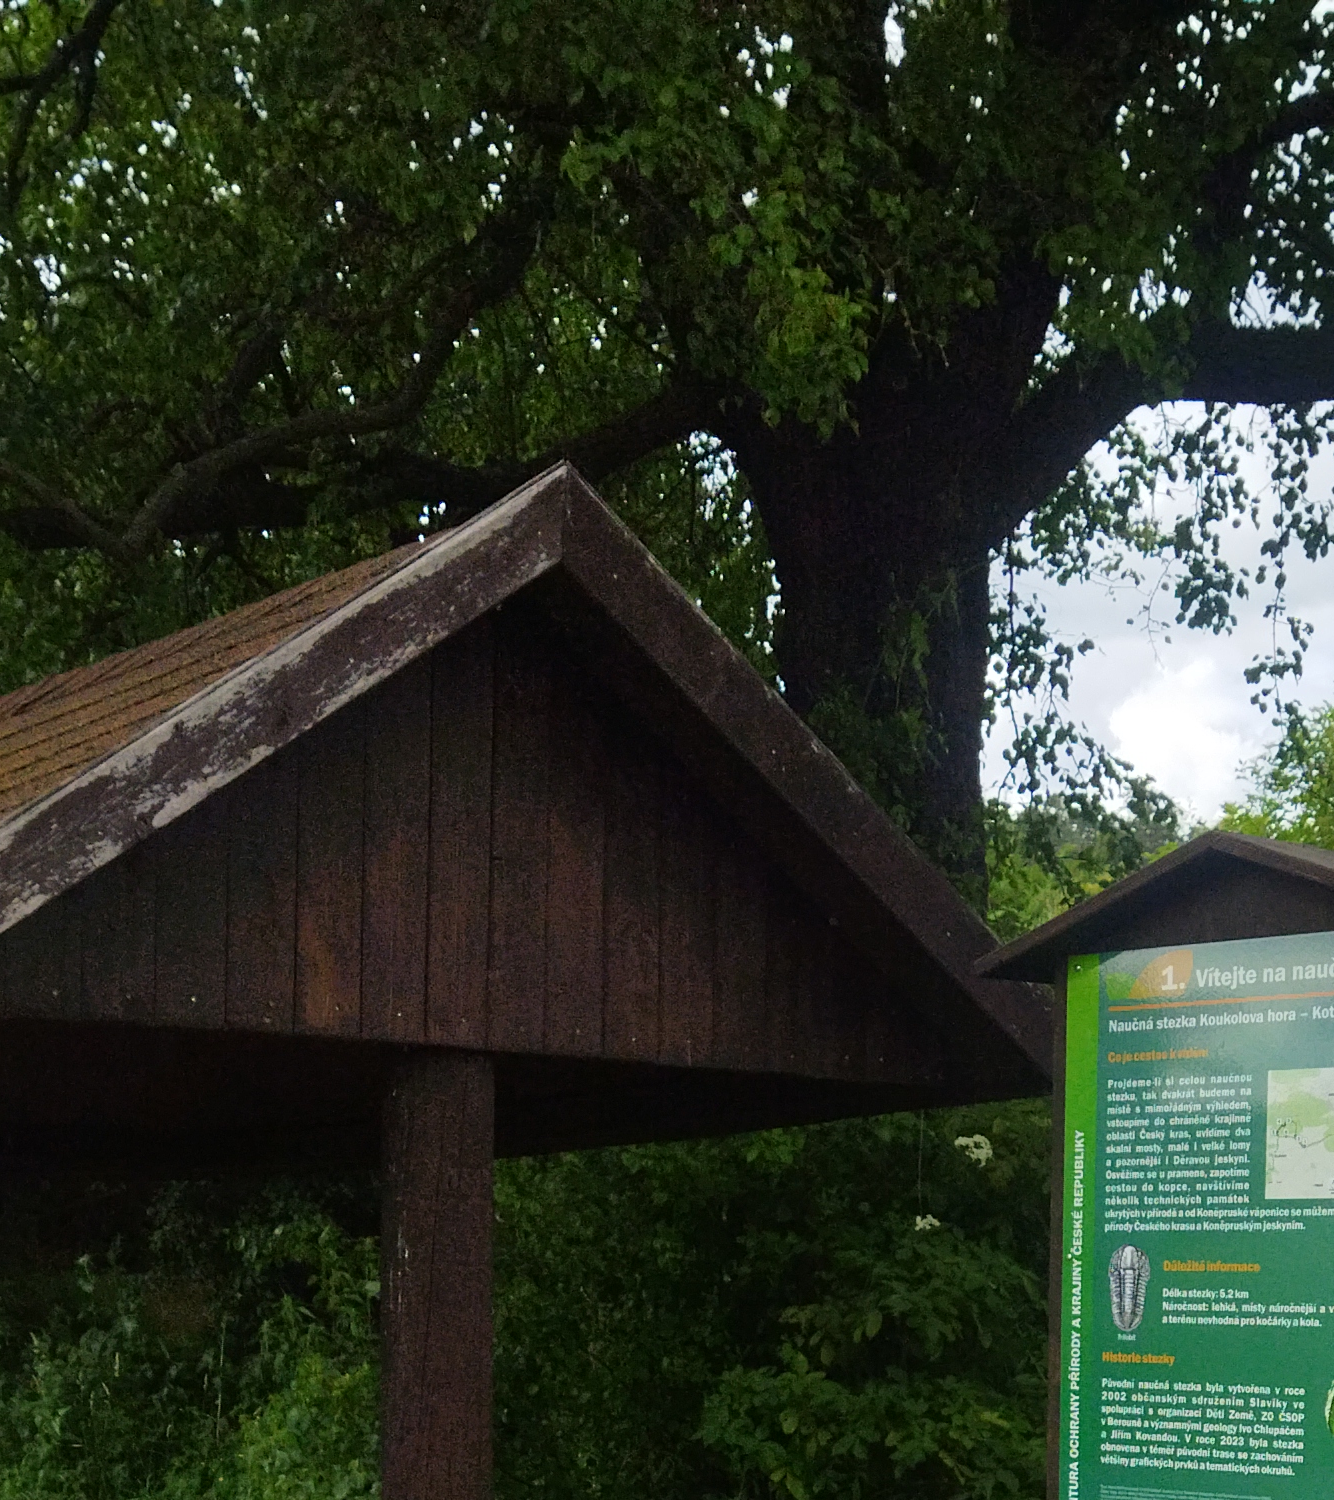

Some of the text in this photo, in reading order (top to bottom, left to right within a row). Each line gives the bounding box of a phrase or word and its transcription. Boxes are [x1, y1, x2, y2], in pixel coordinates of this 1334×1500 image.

[1161, 964, 1186, 990] 1.
[1195, 964, 1257, 991] Vítejte
[1263, 966, 1286, 982] na
[1109, 1017, 1154, 1032] Naučná
[1157, 1015, 1196, 1029] stezka
[1200, 1010, 1264, 1026] Koukolova
[1267, 1008, 1296, 1021] hora
[1107, 1077, 1162, 1089] Projdeme-li
[1179, 1075, 1206, 1085] celou
[1210, 1074, 1252, 1083] naučnou
[1107, 1091, 1138, 1101] stezku,
[1142, 1091, 1157, 1099] tak
[1161, 1089, 1195, 1099] dvakrát
[1199, 1087, 1236, 1097] budeme
[1154, 1116, 1166, 1125] do
[1106, 1127, 1136, 1140] oblasti
[1169, 1129, 1192, 1139] kras,
[1196, 1127, 1231, 1137] uvidíme
[1235, 1126, 1251, 1136] dva
[1105, 1144, 1132, 1153] skalní
[1135, 1143, 1164, 1154] mosty,
[1168, 1142, 1190, 1151] malé
[1201, 1141, 1225, 1150] velké
[1229, 1140, 1251, 1151] lomy
[1173, 1154, 1210, 1164] Děravou
[1075, 1130, 1086, 1206] REPUBLIKY
[1105, 1183, 1137, 1192] cestou
[1142, 1182, 1154, 1191] do
[1158, 1182, 1191, 1192] kopce,
[1105, 1195, 1140, 1205] několik
[1207, 1194, 1250, 1204] památek
[1185, 1208, 1196, 1216] od
[1291, 1208, 1302, 1216] se
[1071, 1210, 1084, 1254] ČESKÉ
[1171, 1222, 1195, 1230] krasu
[1073, 1258, 1083, 1314] KRAJINY
[1162, 1288, 1188, 1297] Délka
[1188, 1288, 1219, 1298] stezky:
[1234, 1289, 1249, 1298] km
[1242, 1302, 1266, 1313] místy
[1169, 1314, 1197, 1323] terénu
[1240, 1317, 1256, 1327] pro
[1299, 1317, 1323, 1326] kola.
[1070, 1331, 1082, 1389] PŘÍRODY
[1173, 1381, 1201, 1391] stezka
[1206, 1382, 1224, 1393] byla
[1284, 1387, 1306, 1395] roce
[1101, 1391, 1127, 1401] 2002
[1249, 1397, 1288, 1412] Slavíky
[1293, 1401, 1305, 1409] ve
[1206, 1408, 1225, 1418] Děti
[1261, 1411, 1274, 1421] ZO
[1278, 1410, 1305, 1422] ČSOP
[1071, 1393, 1081, 1458] OCHRANY
[1107, 1416, 1142, 1427] Berouně
[1203, 1422, 1237, 1434] geology
[1239, 1424, 1252, 1433] Ivo
[1195, 1436, 1215, 1444] roce
[1220, 1435, 1244, 1446] 2023
[1249, 1437, 1268, 1449] byla
[1272, 1439, 1304, 1449] stezka
[1100, 1441, 1140, 1452] obnovena
[1212, 1448, 1235, 1458] trase
[1237, 1451, 1248, 1459] se
[1175, 1459, 1199, 1471] prvků
